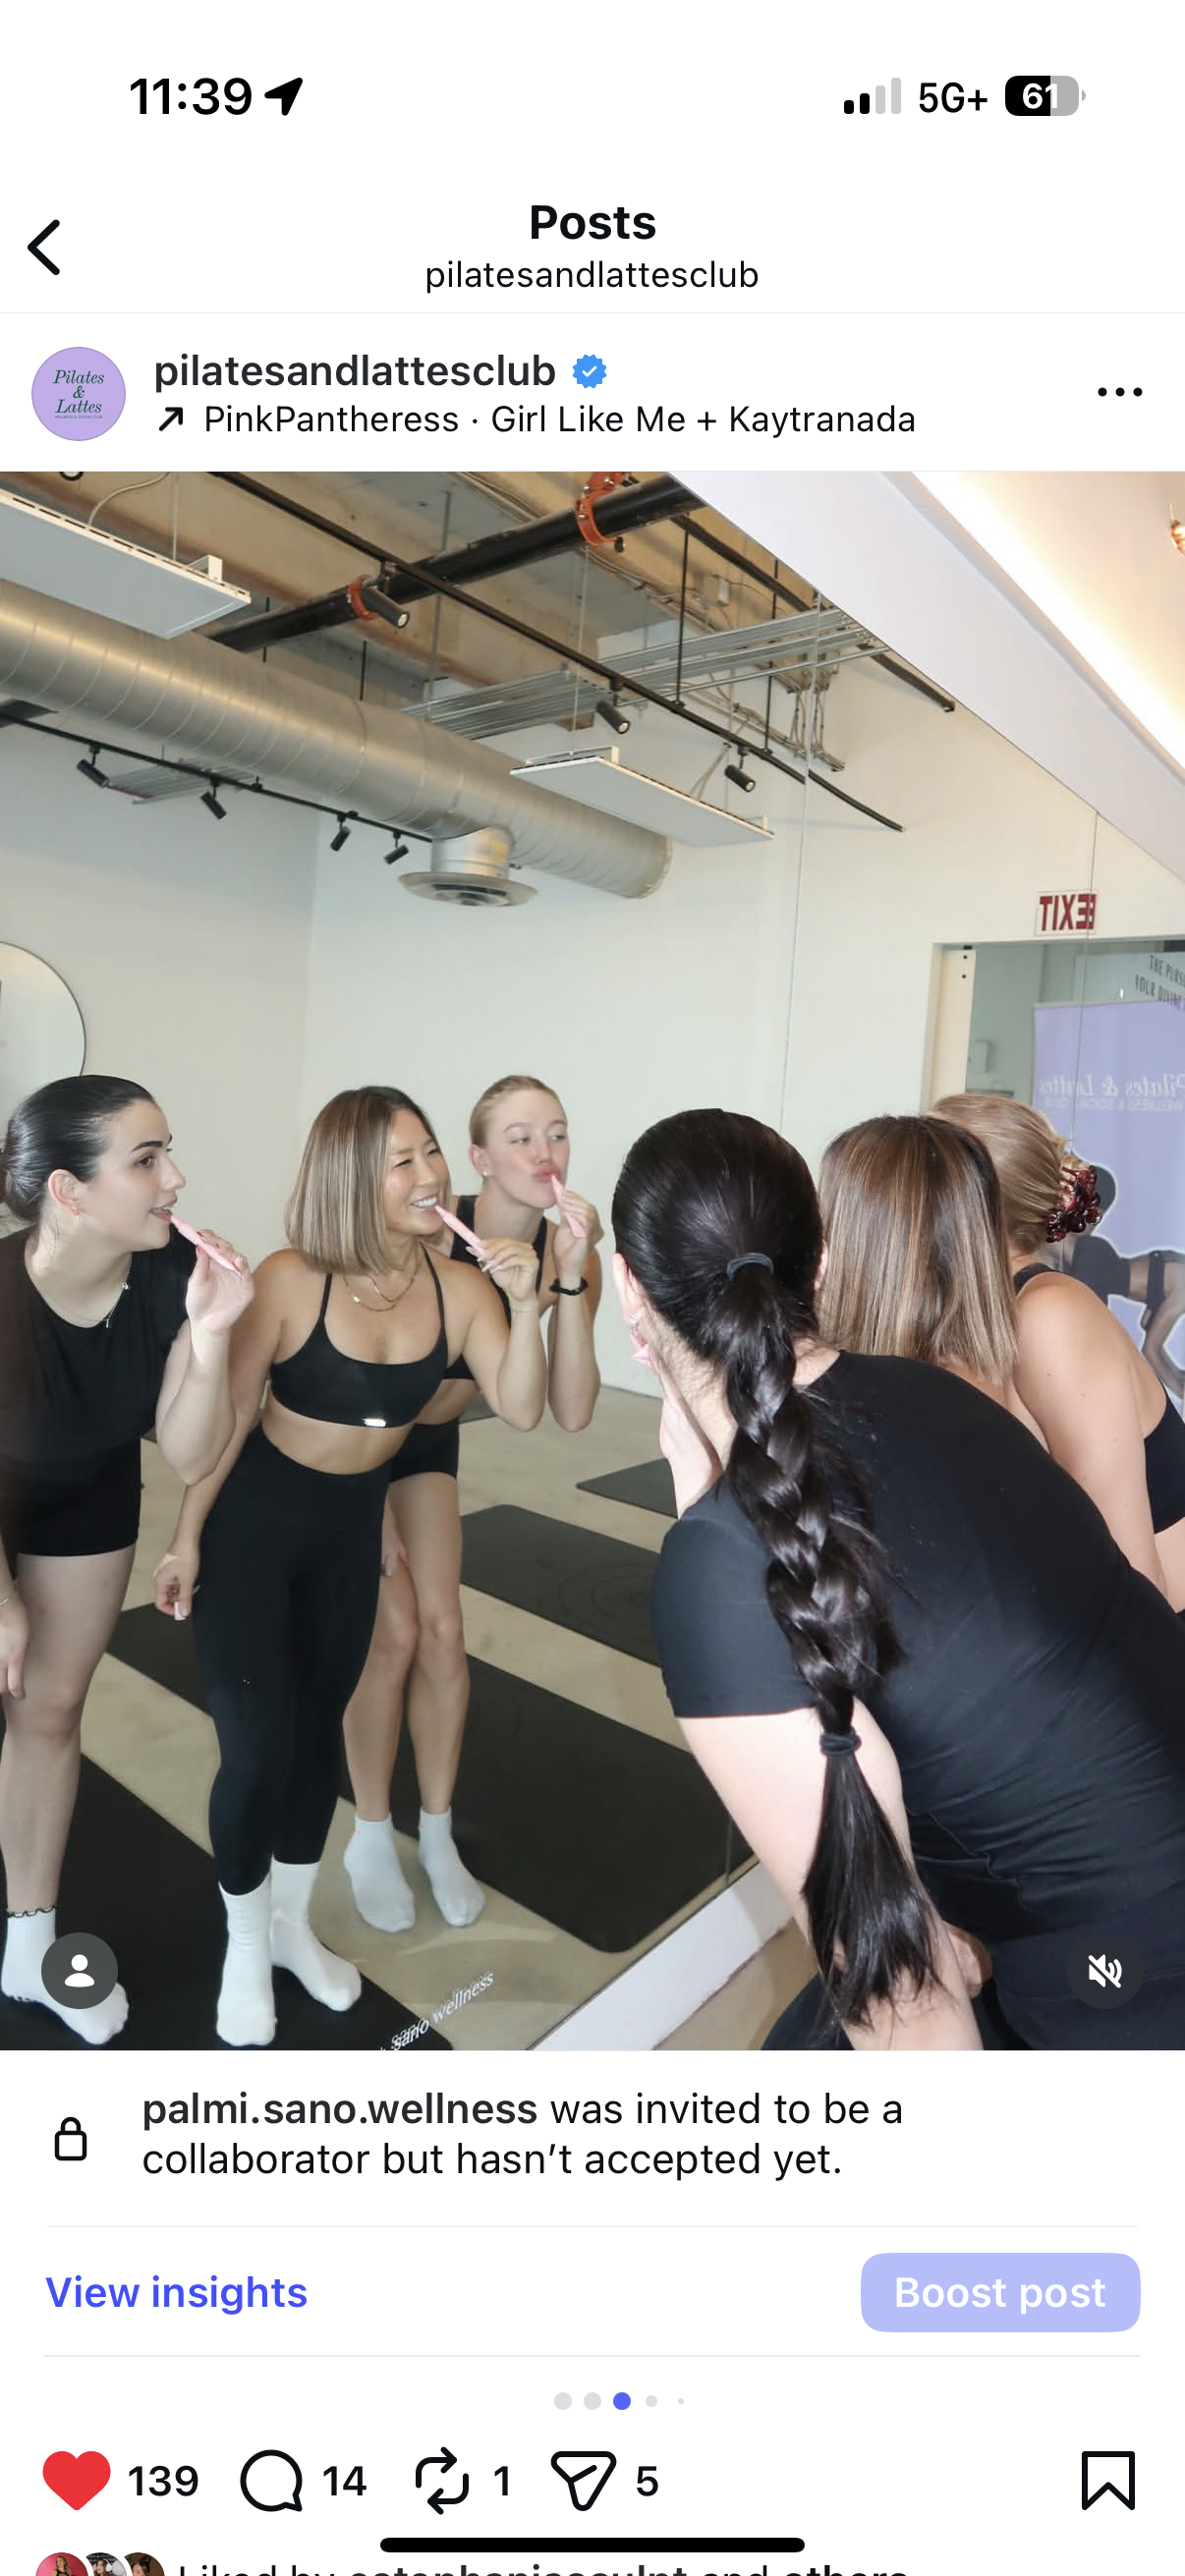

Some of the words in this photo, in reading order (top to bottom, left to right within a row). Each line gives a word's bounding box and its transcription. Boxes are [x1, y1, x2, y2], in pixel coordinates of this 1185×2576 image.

[130, 78, 253, 115] 11:39
[919, 82, 988, 114] 5G+
[1022, 83, 1058, 110] 61
[531, 204, 656, 241] Posts
[426, 259, 760, 295] pilatesandlattesclub
[52, 369, 105, 384] Pilates
[155, 353, 556, 394] pilatesandlattesclub
[55, 399, 102, 414] Lattes
[73, 385, 85, 399] &
[205, 404, 459, 433] PinkPantheress
[491, 404, 545, 433] Girl
[559, 404, 624, 433] Like
[637, 405, 686, 433] Me
[697, 411, 717, 432] +
[730, 404, 915, 439] Kaytranada
[431, 1972, 494, 2024] wellness
[143, 2091, 537, 2132] palmi.sano.wellness
[549, 2100, 623, 2125] was
[637, 2092, 761, 2125] invited
[773, 2095, 811, 2125] to
[824, 2092, 870, 2125] be
[882, 2100, 902, 2125] a
[142, 2142, 370, 2175] collaborator
[383, 2142, 444, 2175] but
[585, 2142, 761, 2182] accepted
[772, 2145, 841, 2182] yet.
[44, 2274, 141, 2309] View
[152, 2274, 308, 2316] insights
[895, 2275, 1008, 2310] Boost
[1020, 2278, 1107, 2316] post
[128, 2464, 199, 2497] 139
[322, 2465, 367, 2496] 14
[493, 2465, 509, 2496] 1
[636, 2465, 659, 2497] 5
